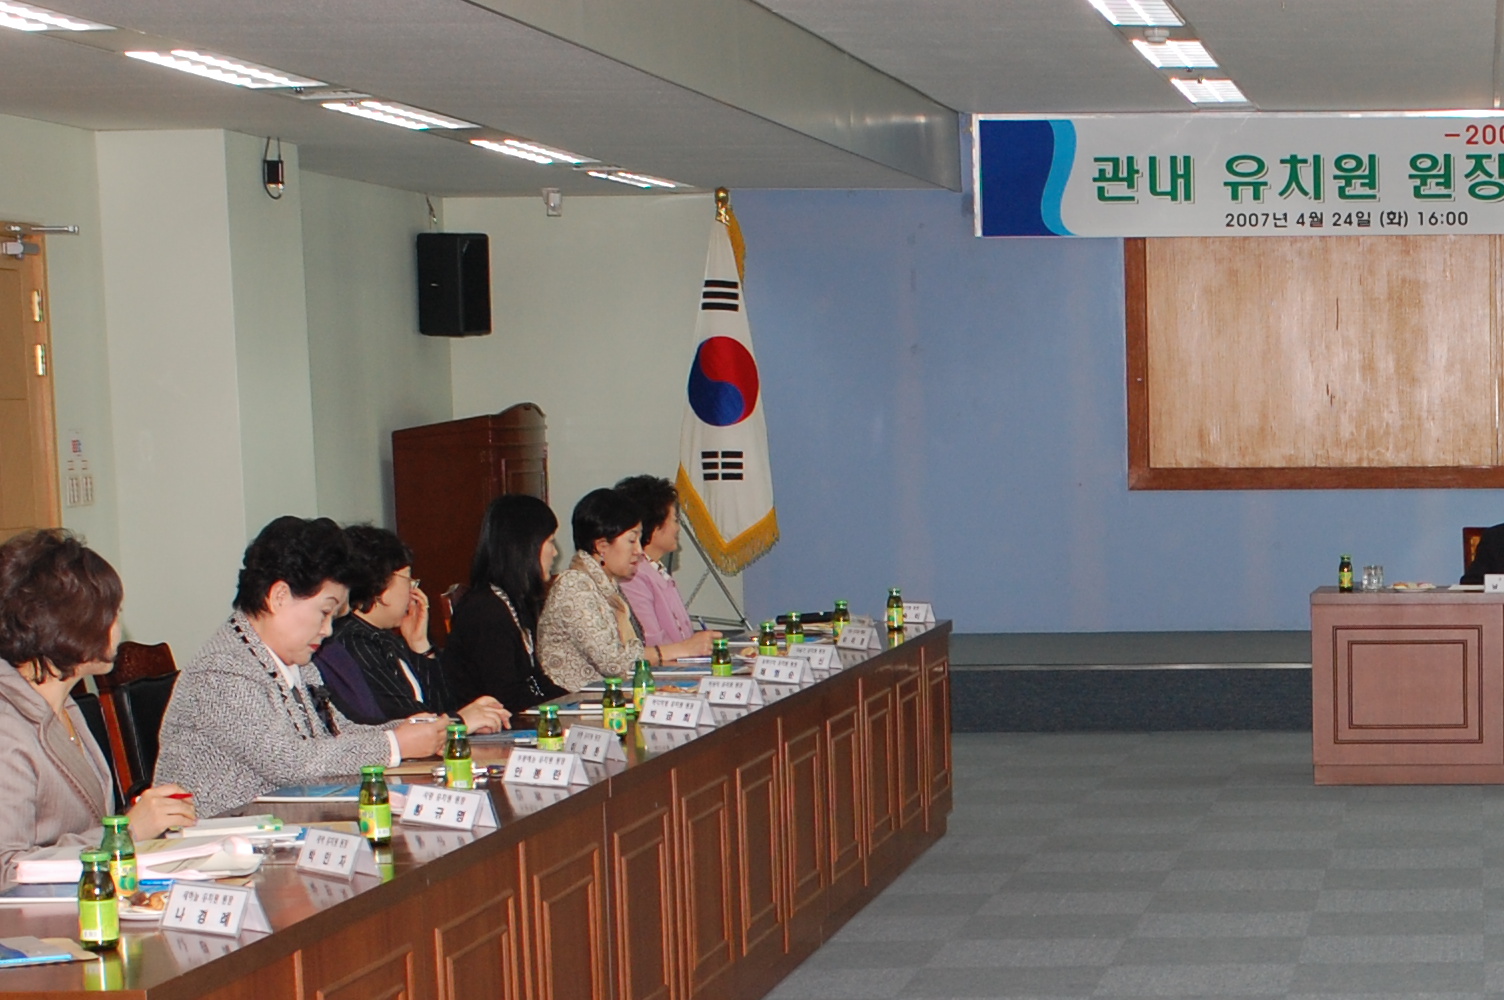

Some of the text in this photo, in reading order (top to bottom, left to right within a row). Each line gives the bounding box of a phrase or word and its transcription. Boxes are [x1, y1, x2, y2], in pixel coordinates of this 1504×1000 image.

[1092, 155, 1193, 202] 관내
[1222, 153, 1379, 202] 유치원
[1225, 210, 1469, 228] 2007년 4월 24일 (화) 16:00
